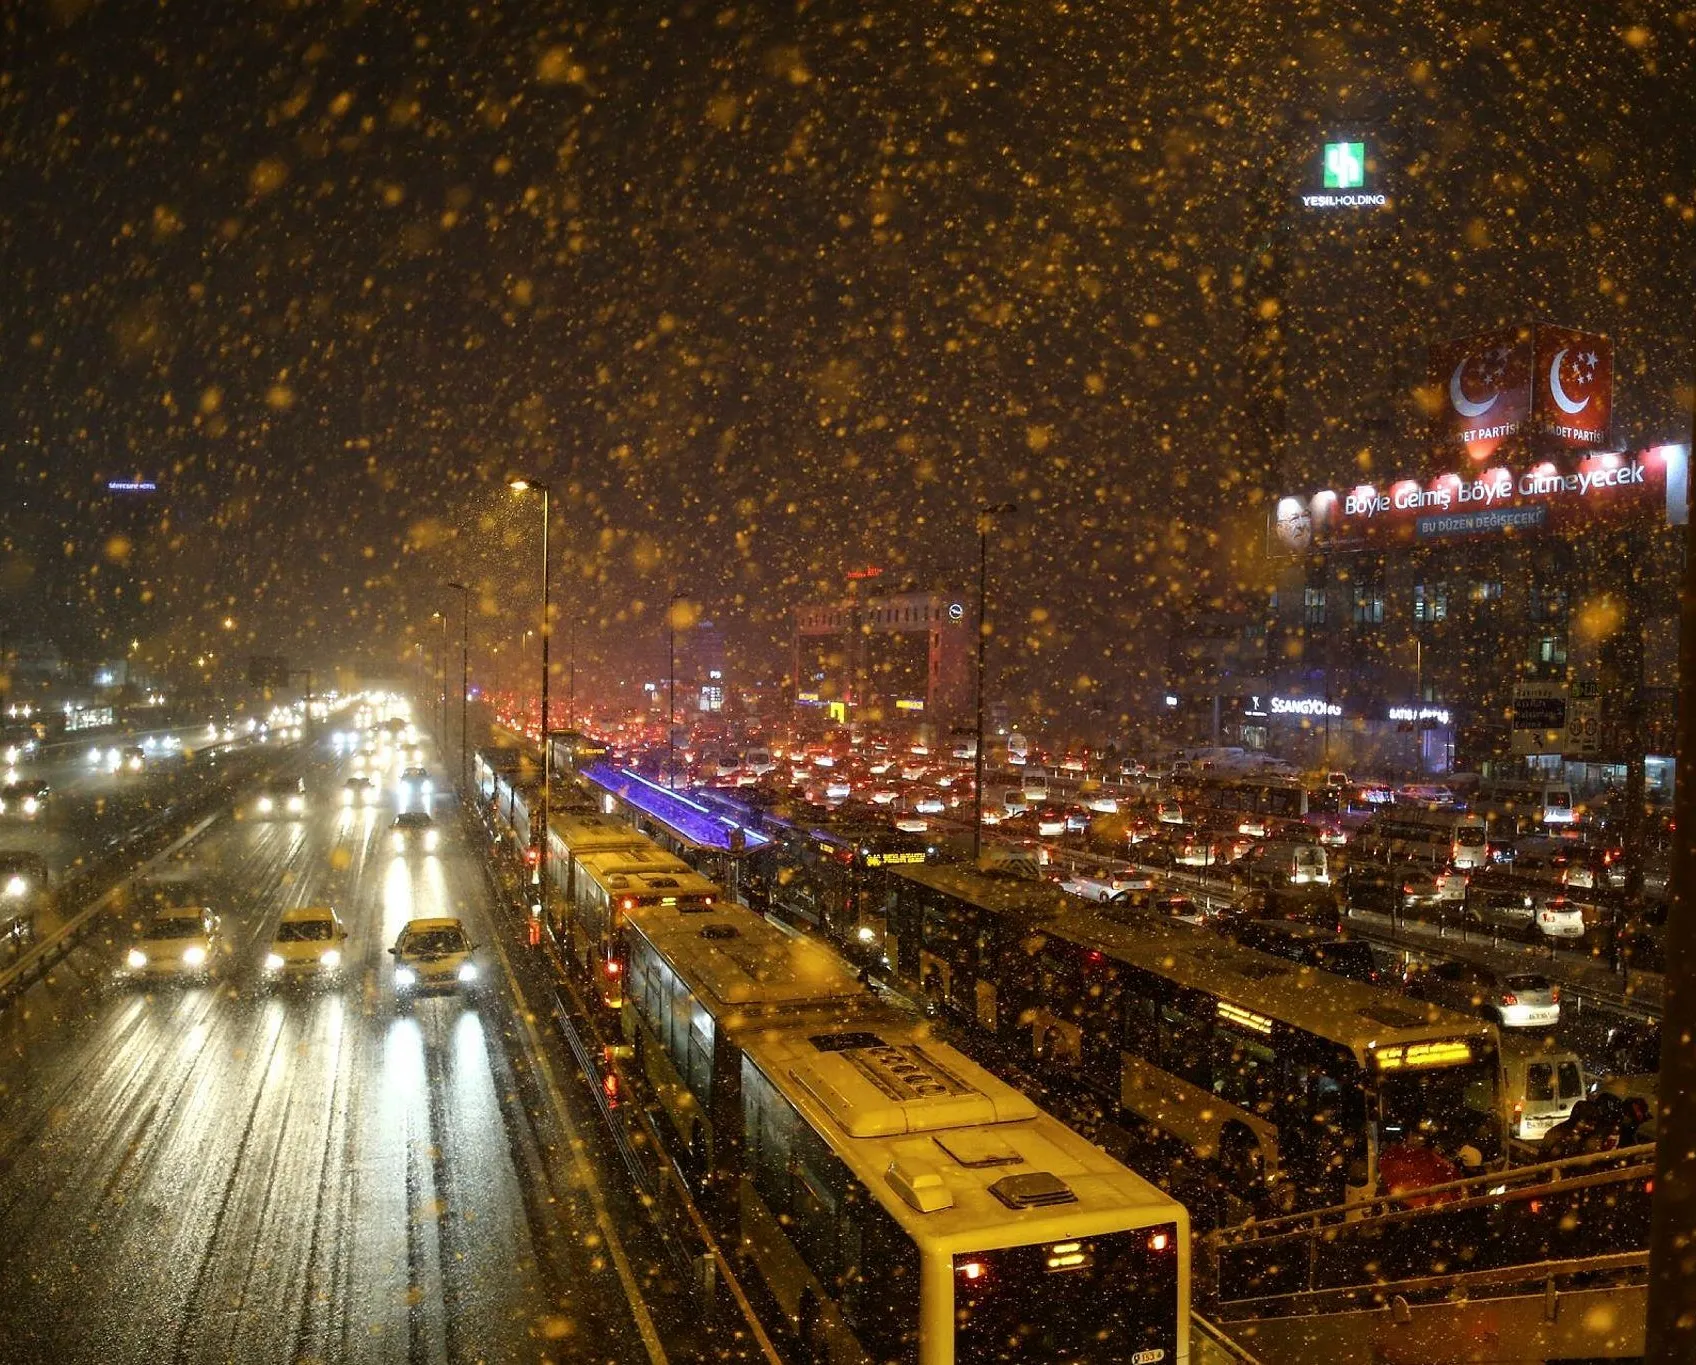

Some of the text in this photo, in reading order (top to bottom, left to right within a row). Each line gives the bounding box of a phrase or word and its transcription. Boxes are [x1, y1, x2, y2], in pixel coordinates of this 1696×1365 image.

[1395, 485, 1451, 510] Gelmiş
[1458, 479, 1513, 505] Böyle
[1518, 459, 1645, 496] Gitmeyecek
[1422, 521, 1436, 533] BU
